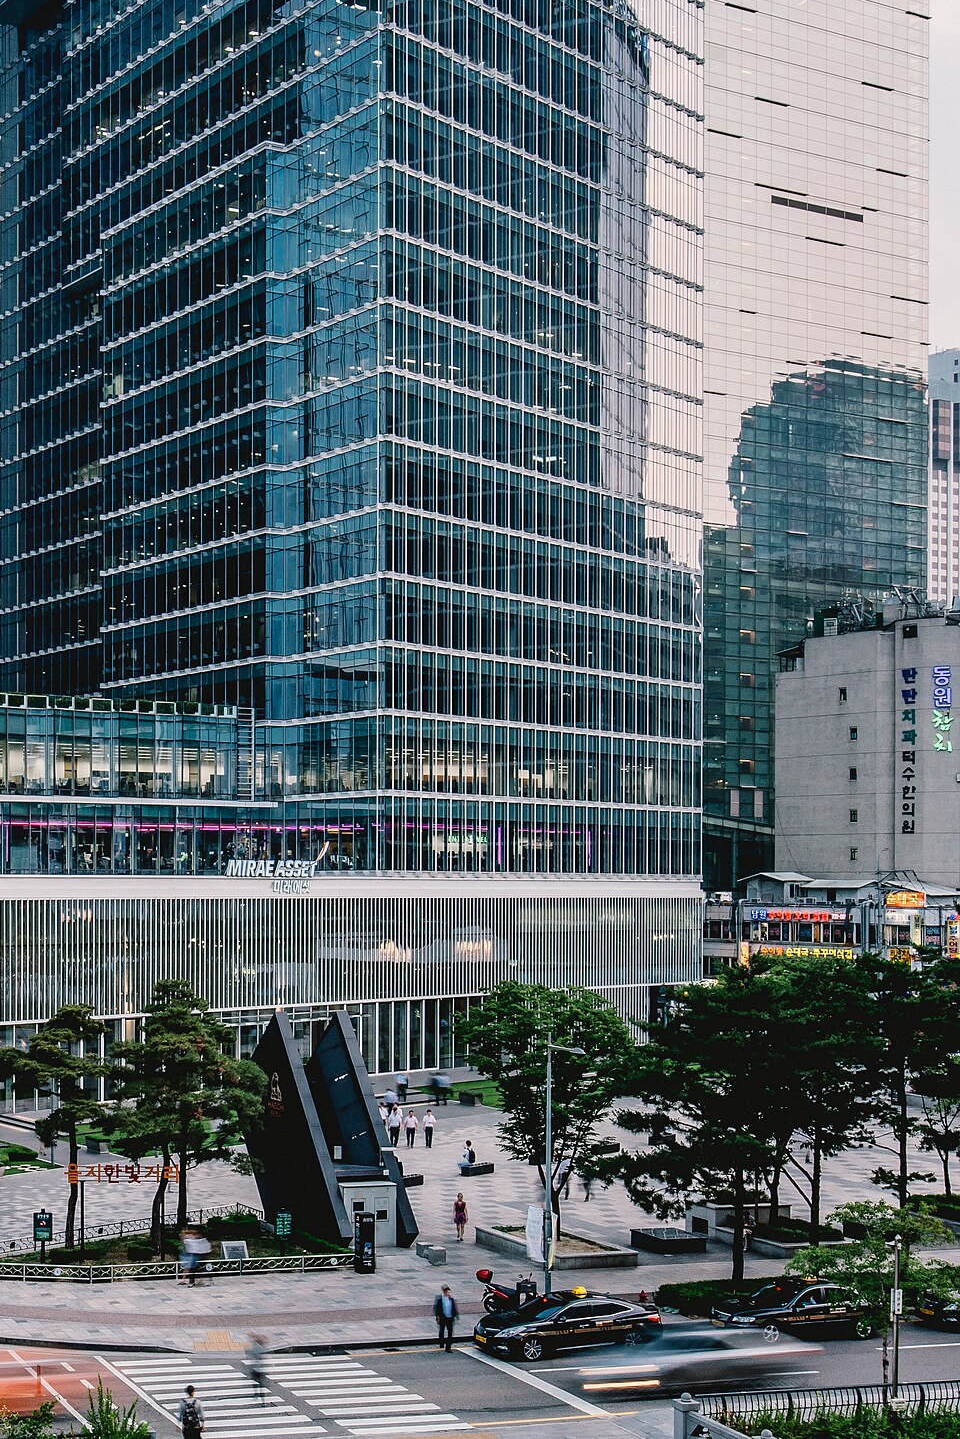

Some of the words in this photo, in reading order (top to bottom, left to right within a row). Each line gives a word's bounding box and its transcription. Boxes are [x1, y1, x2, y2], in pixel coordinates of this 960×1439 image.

[226, 859, 275, 877] MIRAE
[274, 859, 318, 877] ASSET
[273, 879, 311, 894] 미래에셋
[886, 893, 919, 905] 순대국
[64, 1163, 180, 1184] 을지한빛거리
